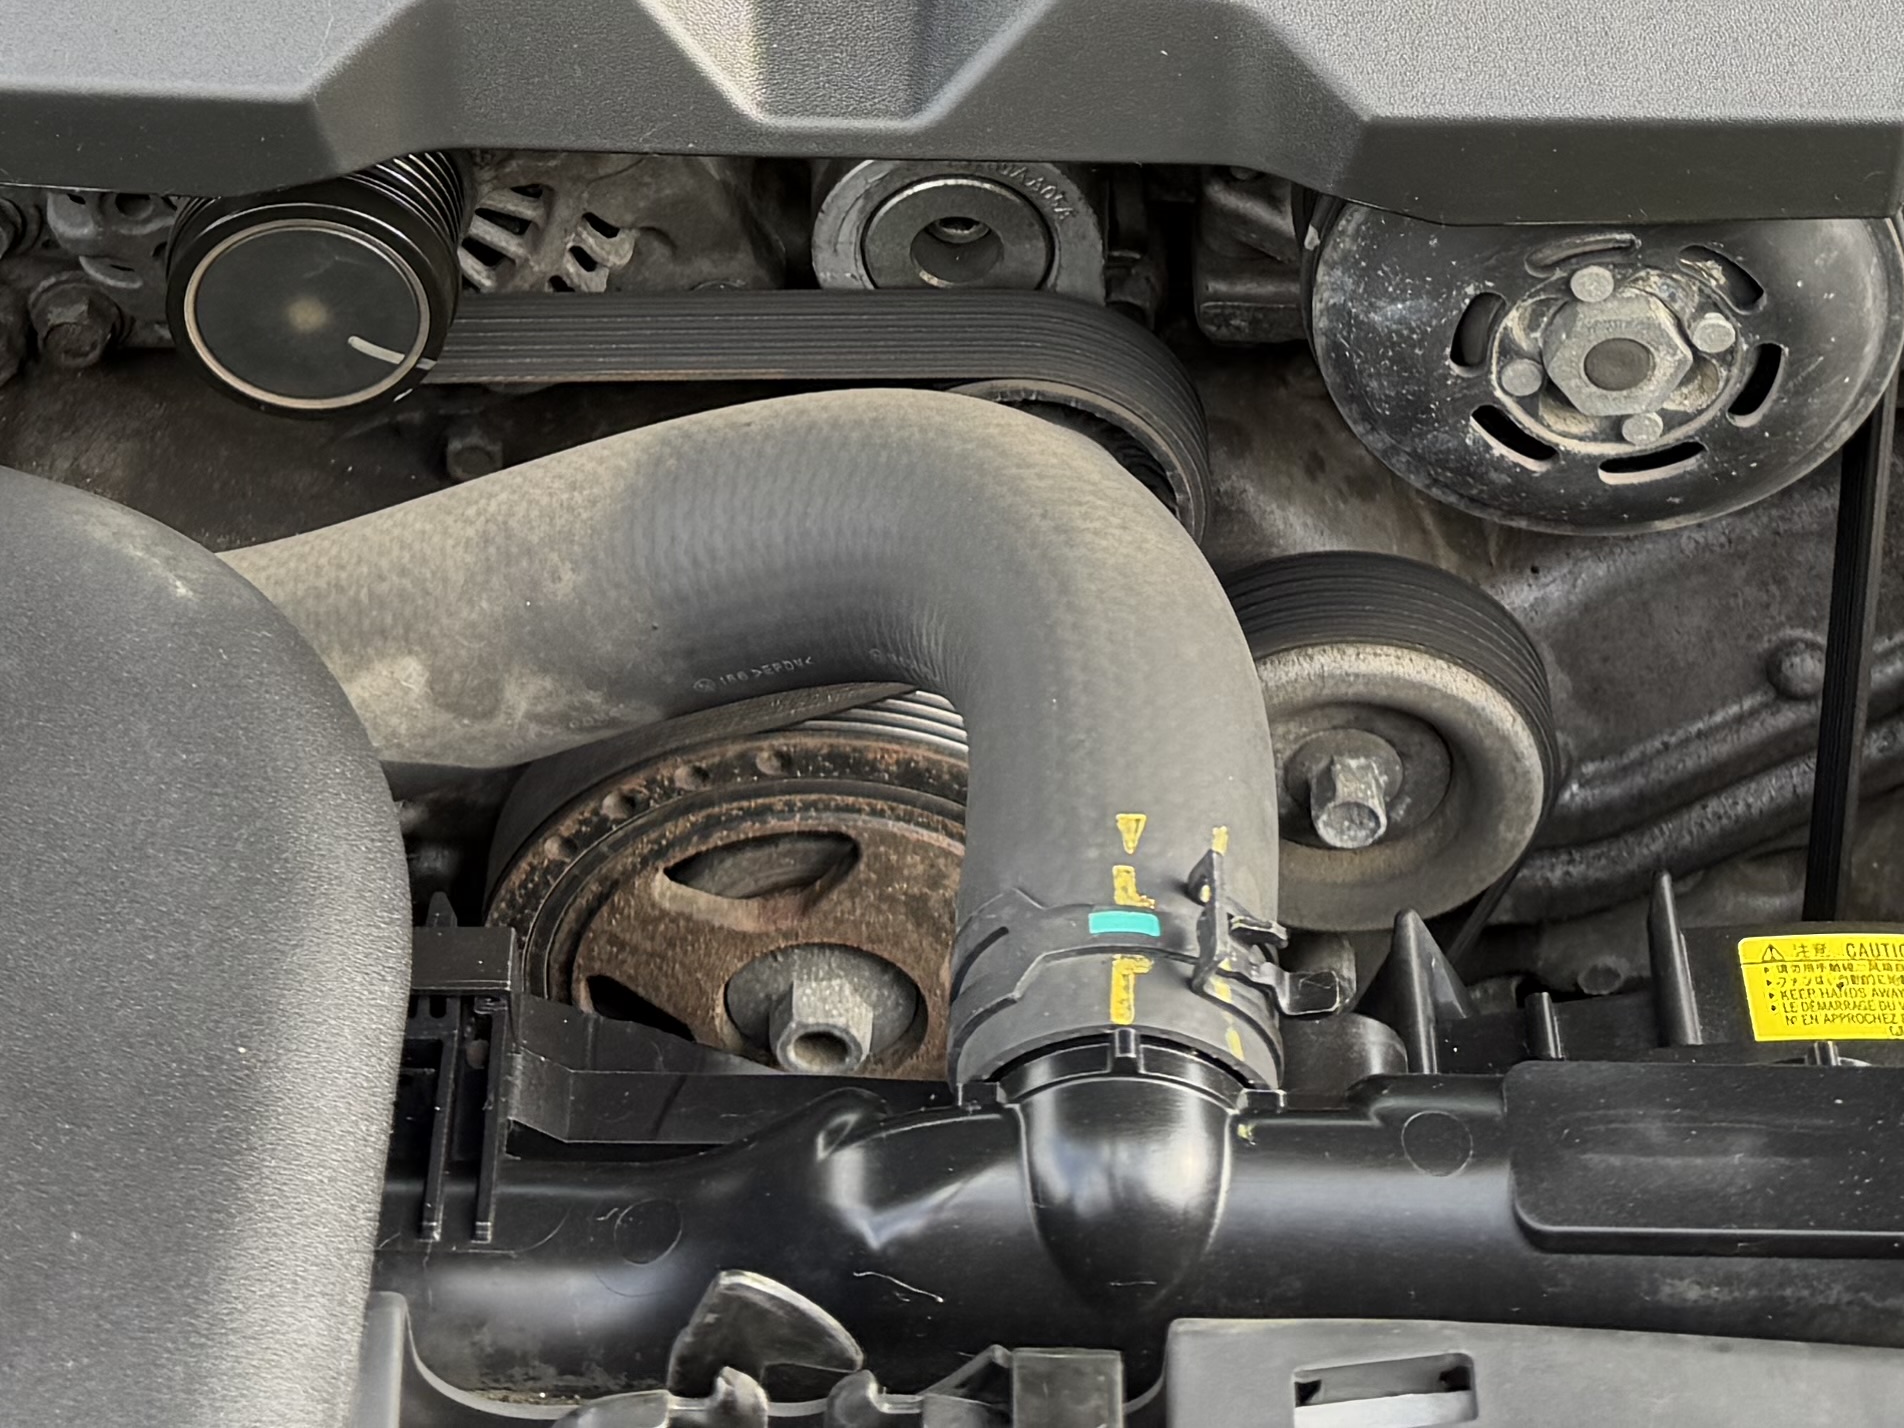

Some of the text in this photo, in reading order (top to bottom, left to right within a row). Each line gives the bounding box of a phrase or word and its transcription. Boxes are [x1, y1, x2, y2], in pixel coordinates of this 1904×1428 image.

[1780, 988, 1816, 1001] KEEP
[1782, 1001, 1798, 1014] LE
[1823, 1012, 1899, 1025] APPROCHEZ
